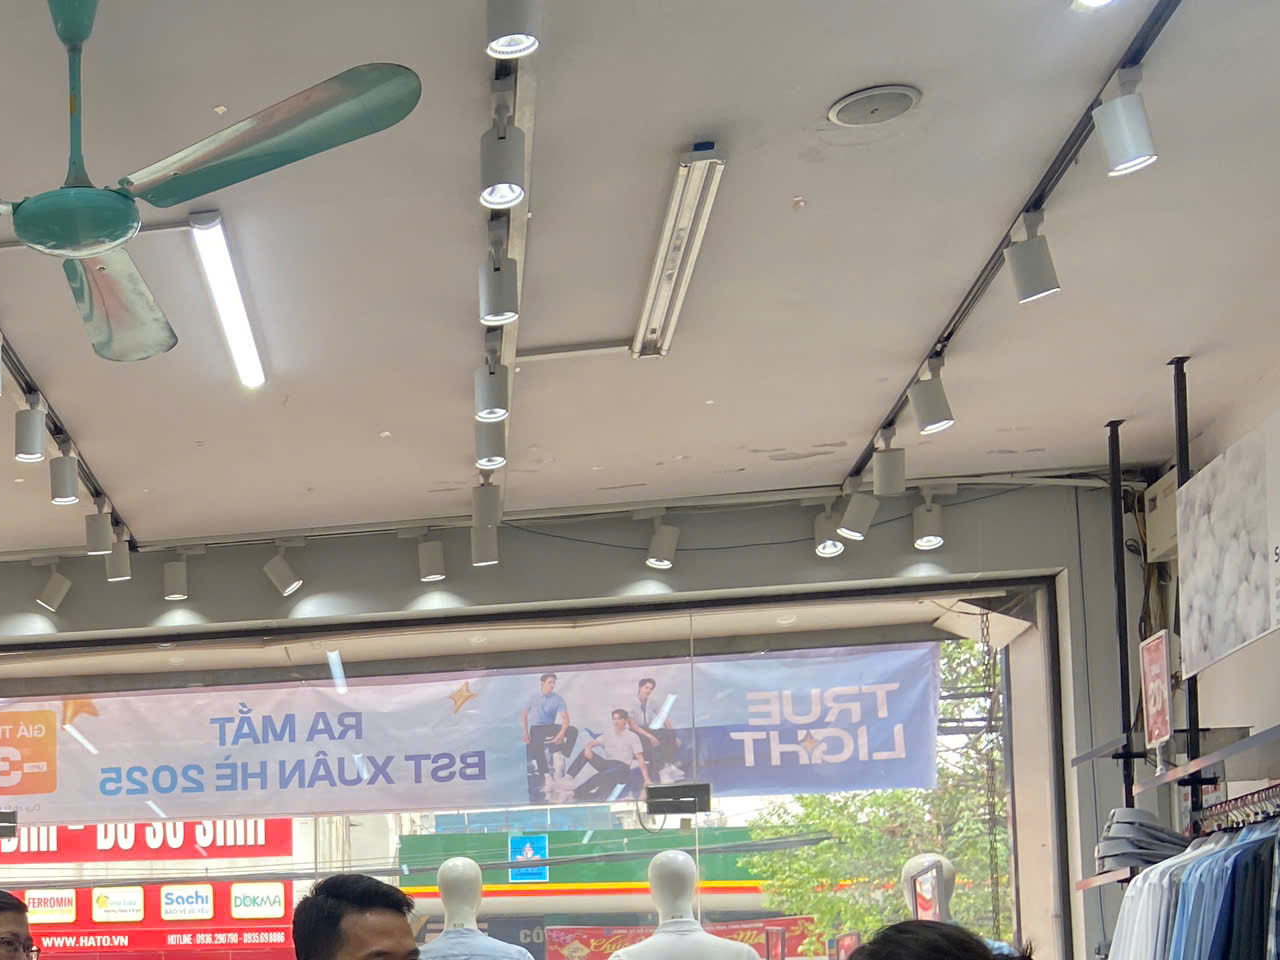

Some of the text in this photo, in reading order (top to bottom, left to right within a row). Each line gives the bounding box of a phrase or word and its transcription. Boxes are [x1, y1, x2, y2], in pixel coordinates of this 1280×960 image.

[28, 896, 74, 909] FERROMIN
[164, 890, 209, 906] Sachi
[41, 936, 129, 948] WWW.HATO.VN
